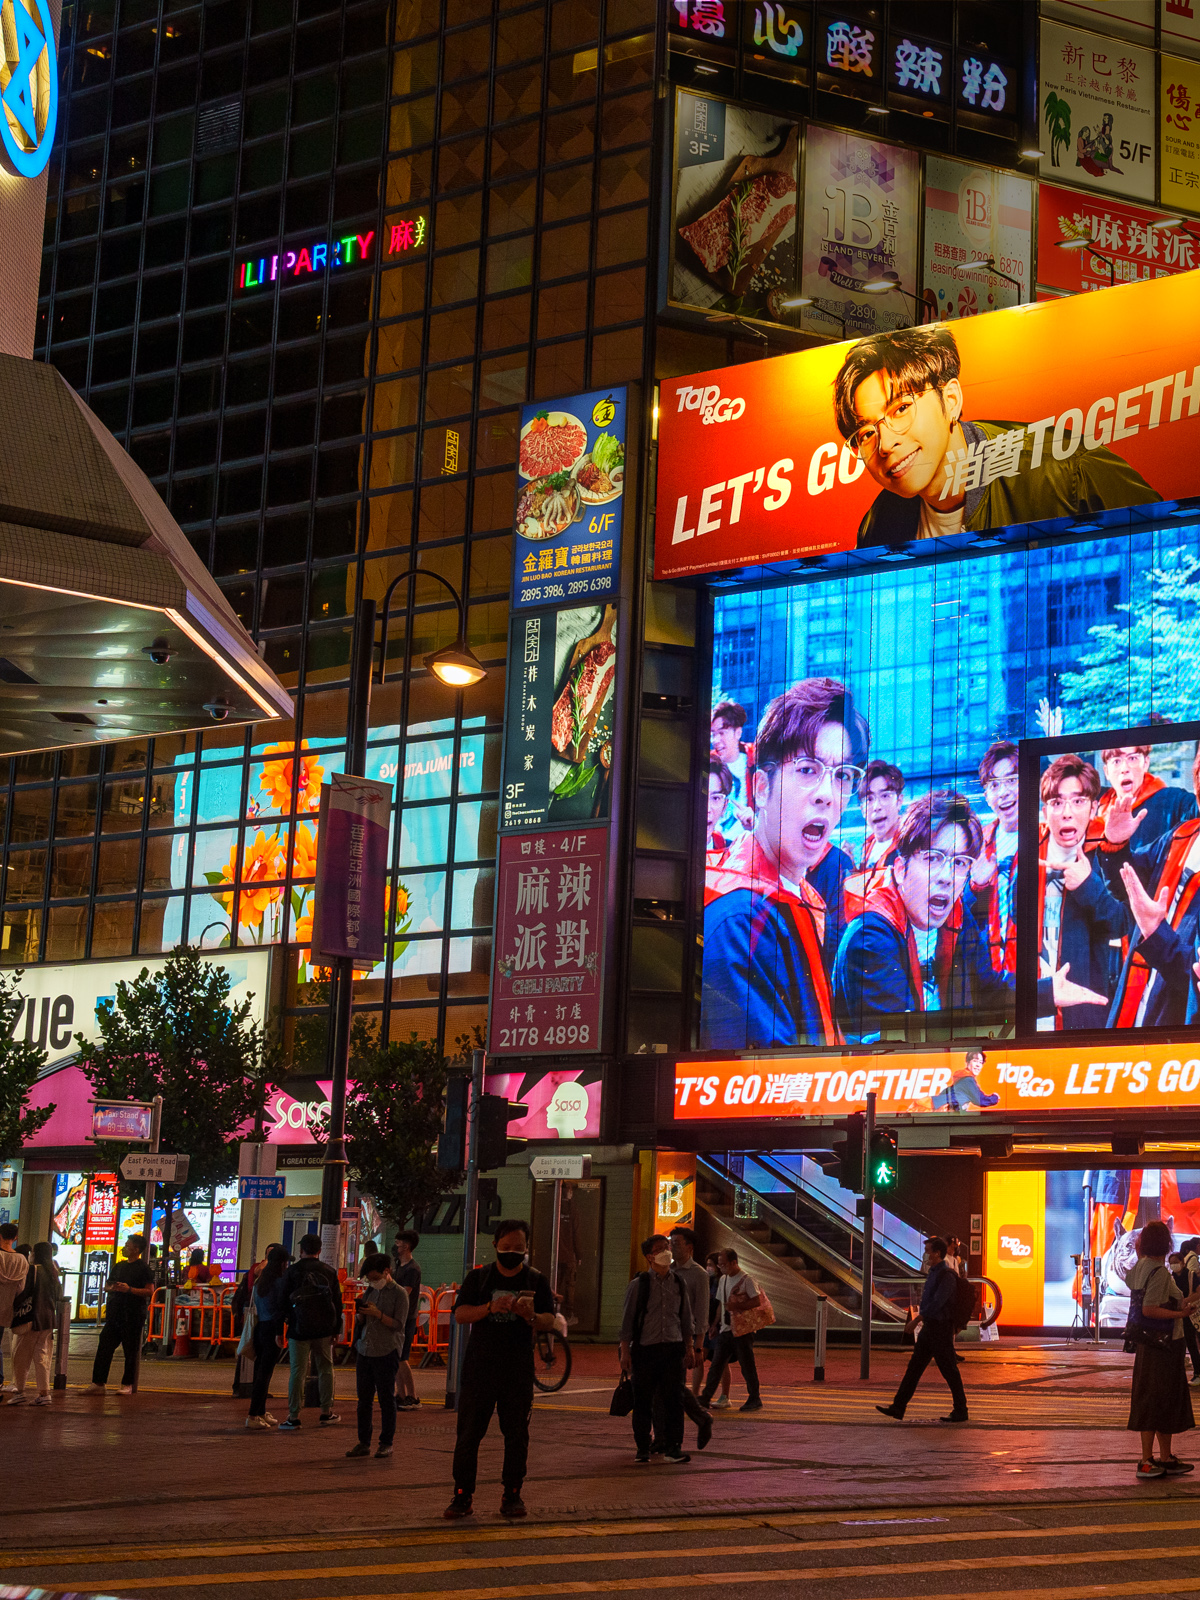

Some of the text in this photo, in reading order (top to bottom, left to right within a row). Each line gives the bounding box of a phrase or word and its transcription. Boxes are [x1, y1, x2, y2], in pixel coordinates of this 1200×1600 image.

[1061, 41, 1140, 84] 新巴黎
[1064, 72, 1138, 102] 正宗越南餐廳
[1044, 81, 1151, 116] New Paris Vietnamese Restaurant
[689, 140, 710, 156] 3F
[1119, 139, 1152, 164] 5/F
[1165, 135, 1182, 146] SOUR
[1182, 139, 1195, 149] AND
[820, 242, 898, 268] ISLAND BEVERLEY
[934, 242, 1024, 277] 租務查詢 6870
[850, 302, 878, 321] 2890
[671, 455, 792, 546] LET'S
[807, 440, 866, 496] GO
[588, 513, 616, 534] 6/F
[523, 547, 569, 573] 金羅寶
[570, 549, 613, 566] 韓國料理
[521, 575, 530, 583] JIN
[530, 573, 541, 581] LUO
[541, 572, 553, 580] BAO
[553, 568, 575, 578] KOREAN
[520, 576, 612, 602] 2895 3986, 2895 6398
[505, 782, 525, 800] 3F
[504, 818, 522, 827] 2619
[559, 835, 587, 853] 4/F
[346, 823, 366, 950] 香港亞洲國際都會
[514, 862, 593, 916] 麻辣
[513, 919, 590, 972] 派對
[511, 975, 586, 997] CHILI PARTY
[499, 1024, 590, 1048] 2178 4898
[1064, 1061, 1152, 1095] LET'S
[723, 1074, 761, 1106] GO
[105, 1109, 139, 1119] Taxi Stand
[107, 1121, 135, 1133] 的士站
[127, 1156, 176, 1165] East Point Road
[286, 1157, 307, 1165] GREAT
[540, 1158, 582, 1166] East Point Road
[138, 1167, 163, 1178] 東角道
[550, 1167, 571, 1176] 東角道
[248, 1178, 276, 1187] Taxi Stand
[249, 1187, 273, 1197] 的士站
[216, 1246, 232, 1258] 8/F
